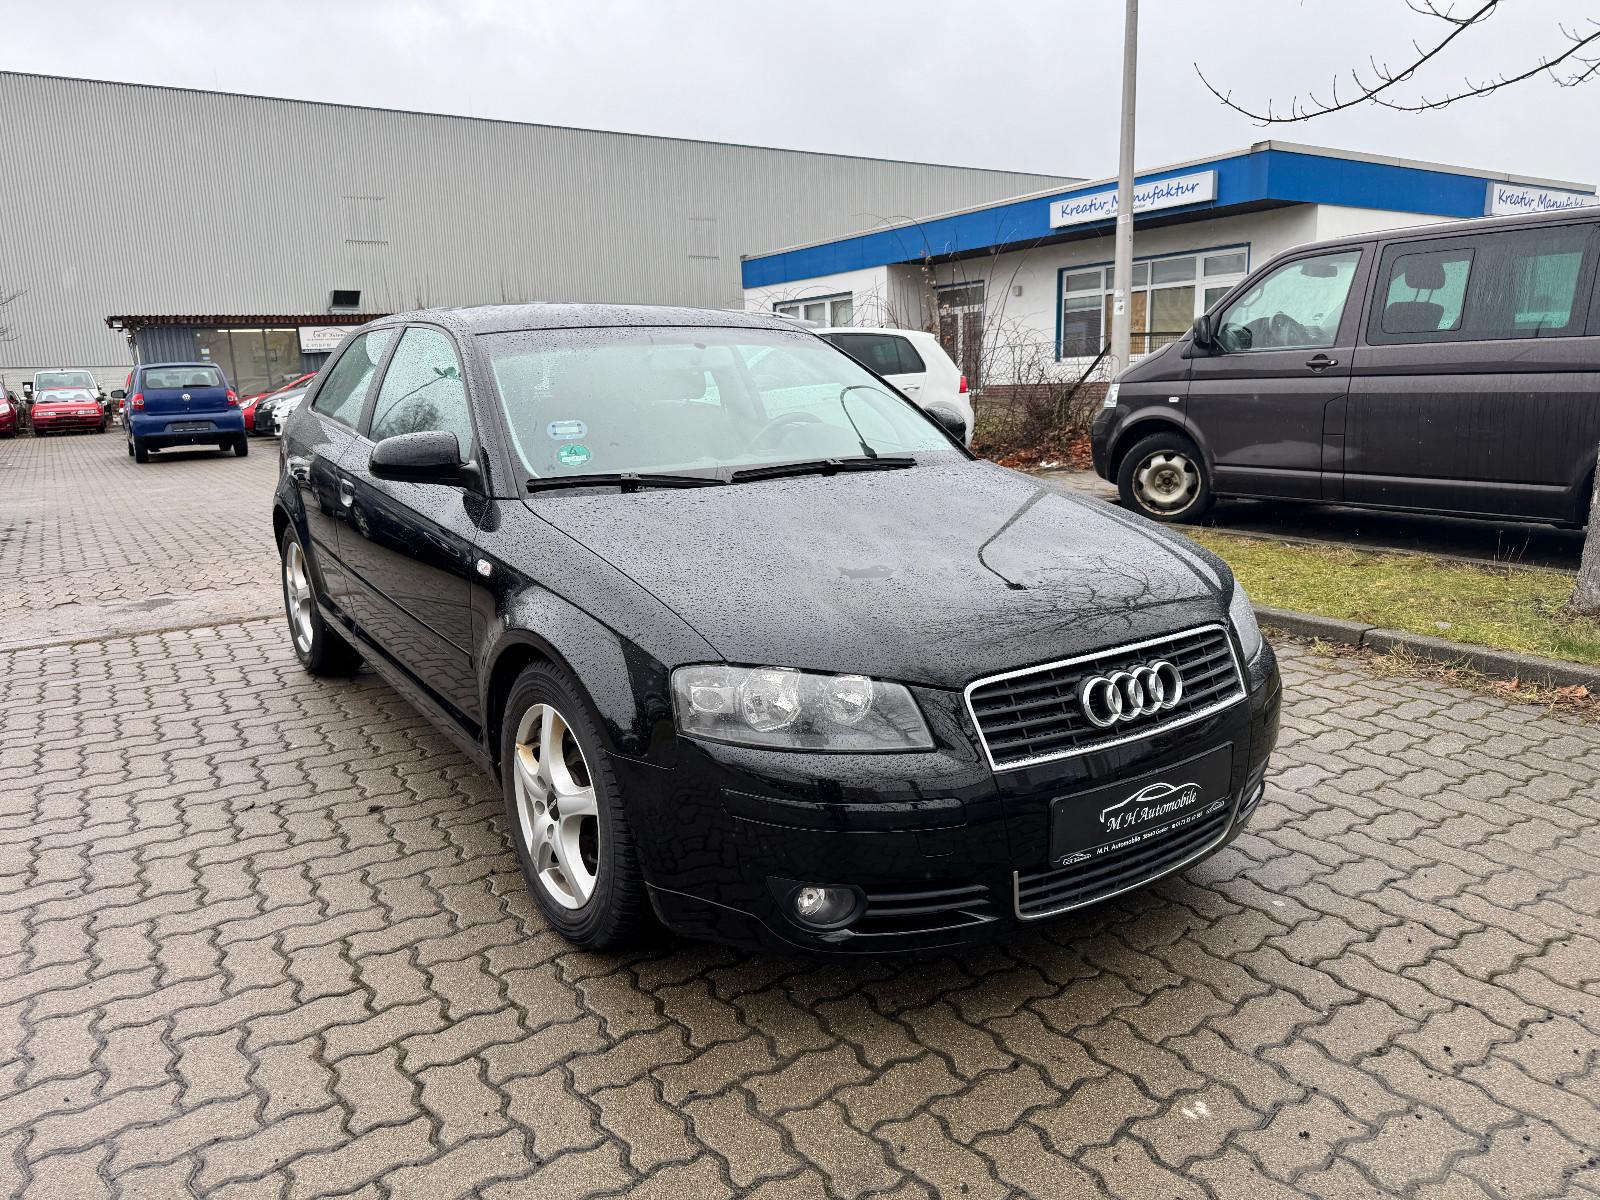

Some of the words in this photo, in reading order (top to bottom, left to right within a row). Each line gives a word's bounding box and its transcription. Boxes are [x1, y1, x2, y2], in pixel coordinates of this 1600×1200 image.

[1061, 197, 1108, 218] Kreativ
[1111, 181, 1200, 207] Mnufaktur
[1498, 188, 1535, 208] Kreativ
[1106, 812, 1124, 833] M
[1124, 808, 1139, 827] H
[1137, 787, 1197, 823] Automobile
[1111, 836, 1141, 850] Automobile
